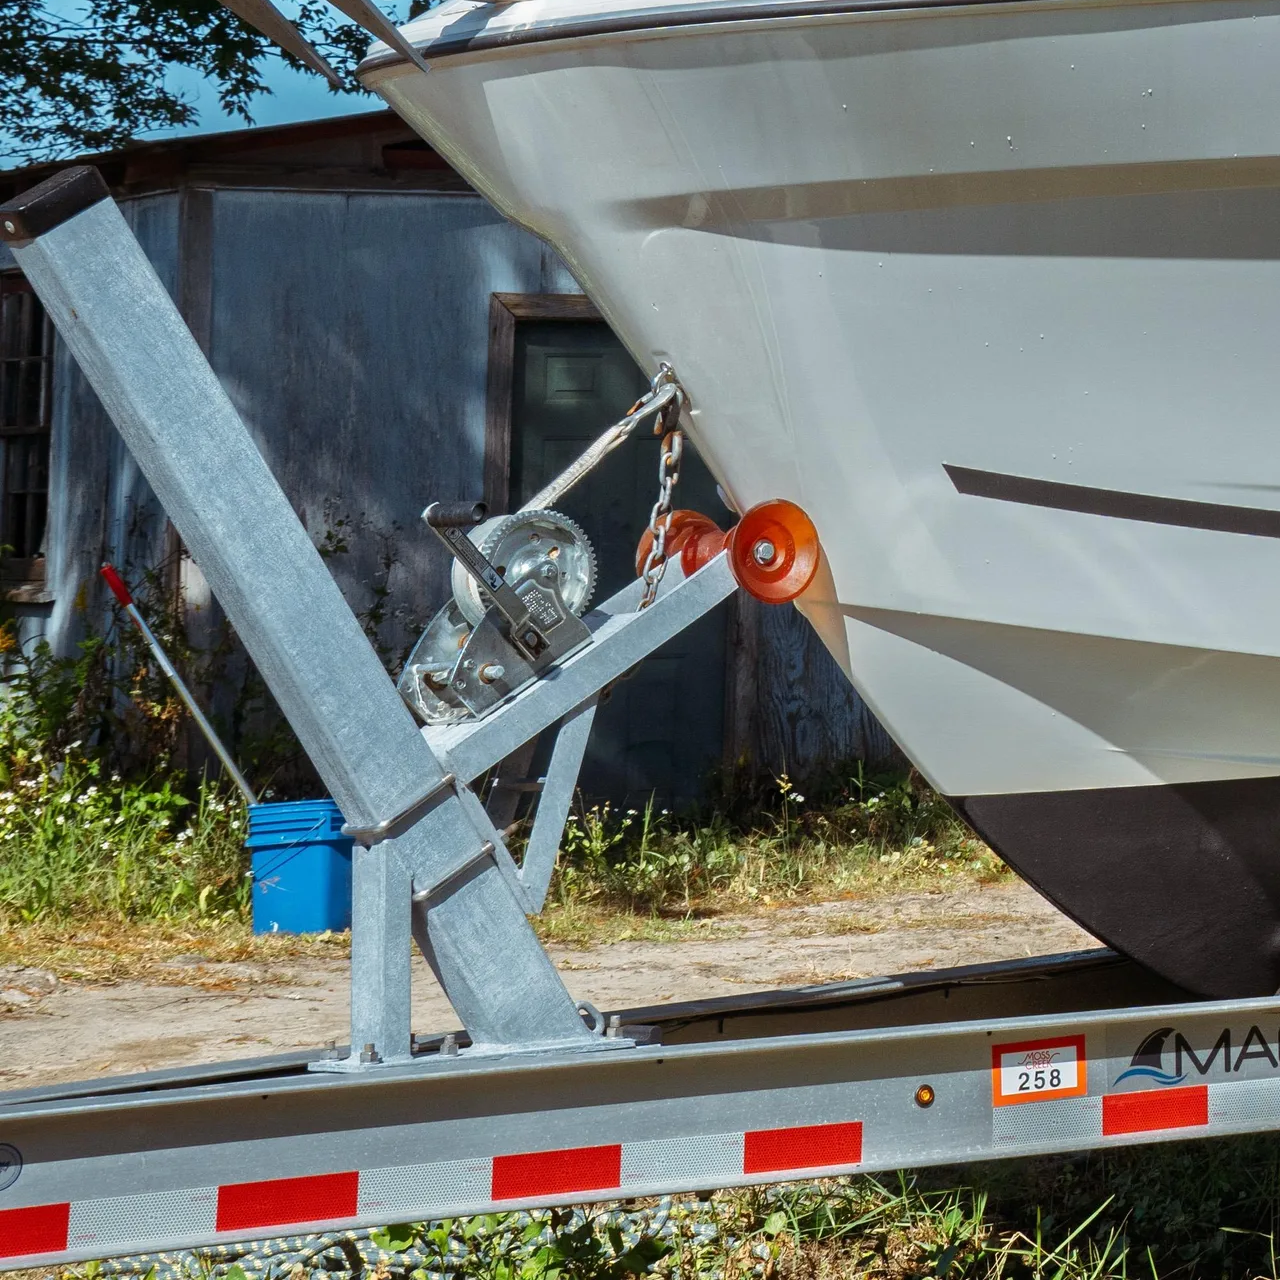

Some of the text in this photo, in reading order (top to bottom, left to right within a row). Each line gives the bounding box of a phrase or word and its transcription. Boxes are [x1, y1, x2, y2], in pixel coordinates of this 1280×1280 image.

[1018, 1050, 1051, 1064] MOSS
[1025, 1059, 1053, 1071] CREEK
[1018, 1068, 1062, 1091] 258
